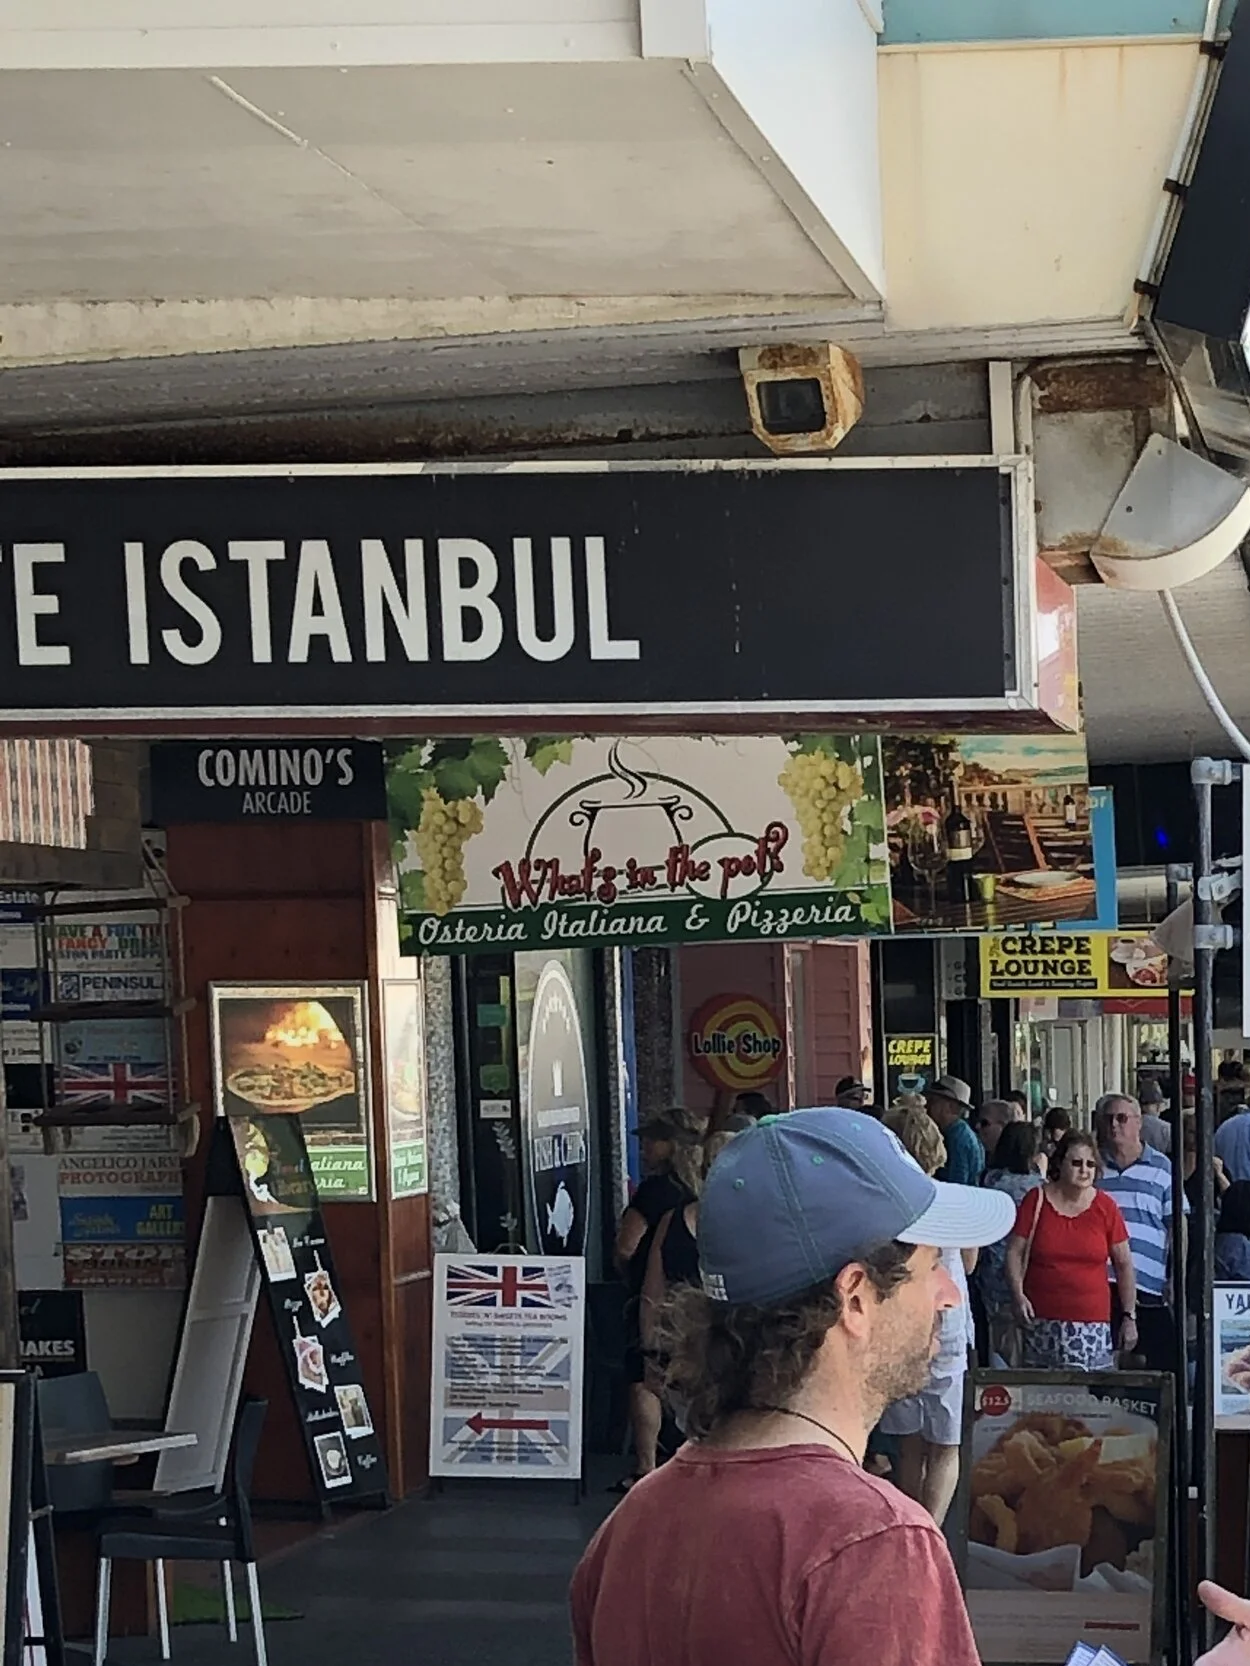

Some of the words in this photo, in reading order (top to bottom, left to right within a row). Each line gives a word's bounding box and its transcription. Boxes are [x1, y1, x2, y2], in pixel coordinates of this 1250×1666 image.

[0, 542, 71, 666] E
[124, 535, 641, 665] ISTANBUL
[198, 748, 355, 788] COMINO'S
[242, 791, 312, 815] ARCADE
[625, 857, 657, 889] in
[664, 844, 710, 893] the
[718, 820, 788, 900] pot?
[418, 916, 527, 945] Osteria
[540, 909, 668, 939] Italiana
[685, 903, 710, 930] &
[726, 895, 856, 934] Pizzeria
[58, 937, 108, 949] FANCY
[1001, 935, 1093, 956] CREPE
[989, 959, 1092, 977] LOUNGE
[82, 976, 168, 989] PENINSUL
[692, 1032, 735, 1055] Lollie
[742, 1032, 782, 1060] Shop
[888, 1039, 932, 1053] CREPE
[888, 1053, 932, 1066] LOUNGE
[310, 1155, 366, 1171] aliana
[1027, 1392, 1098, 1406] SEAFOOD
[1102, 1396, 1158, 1415] BASKET
